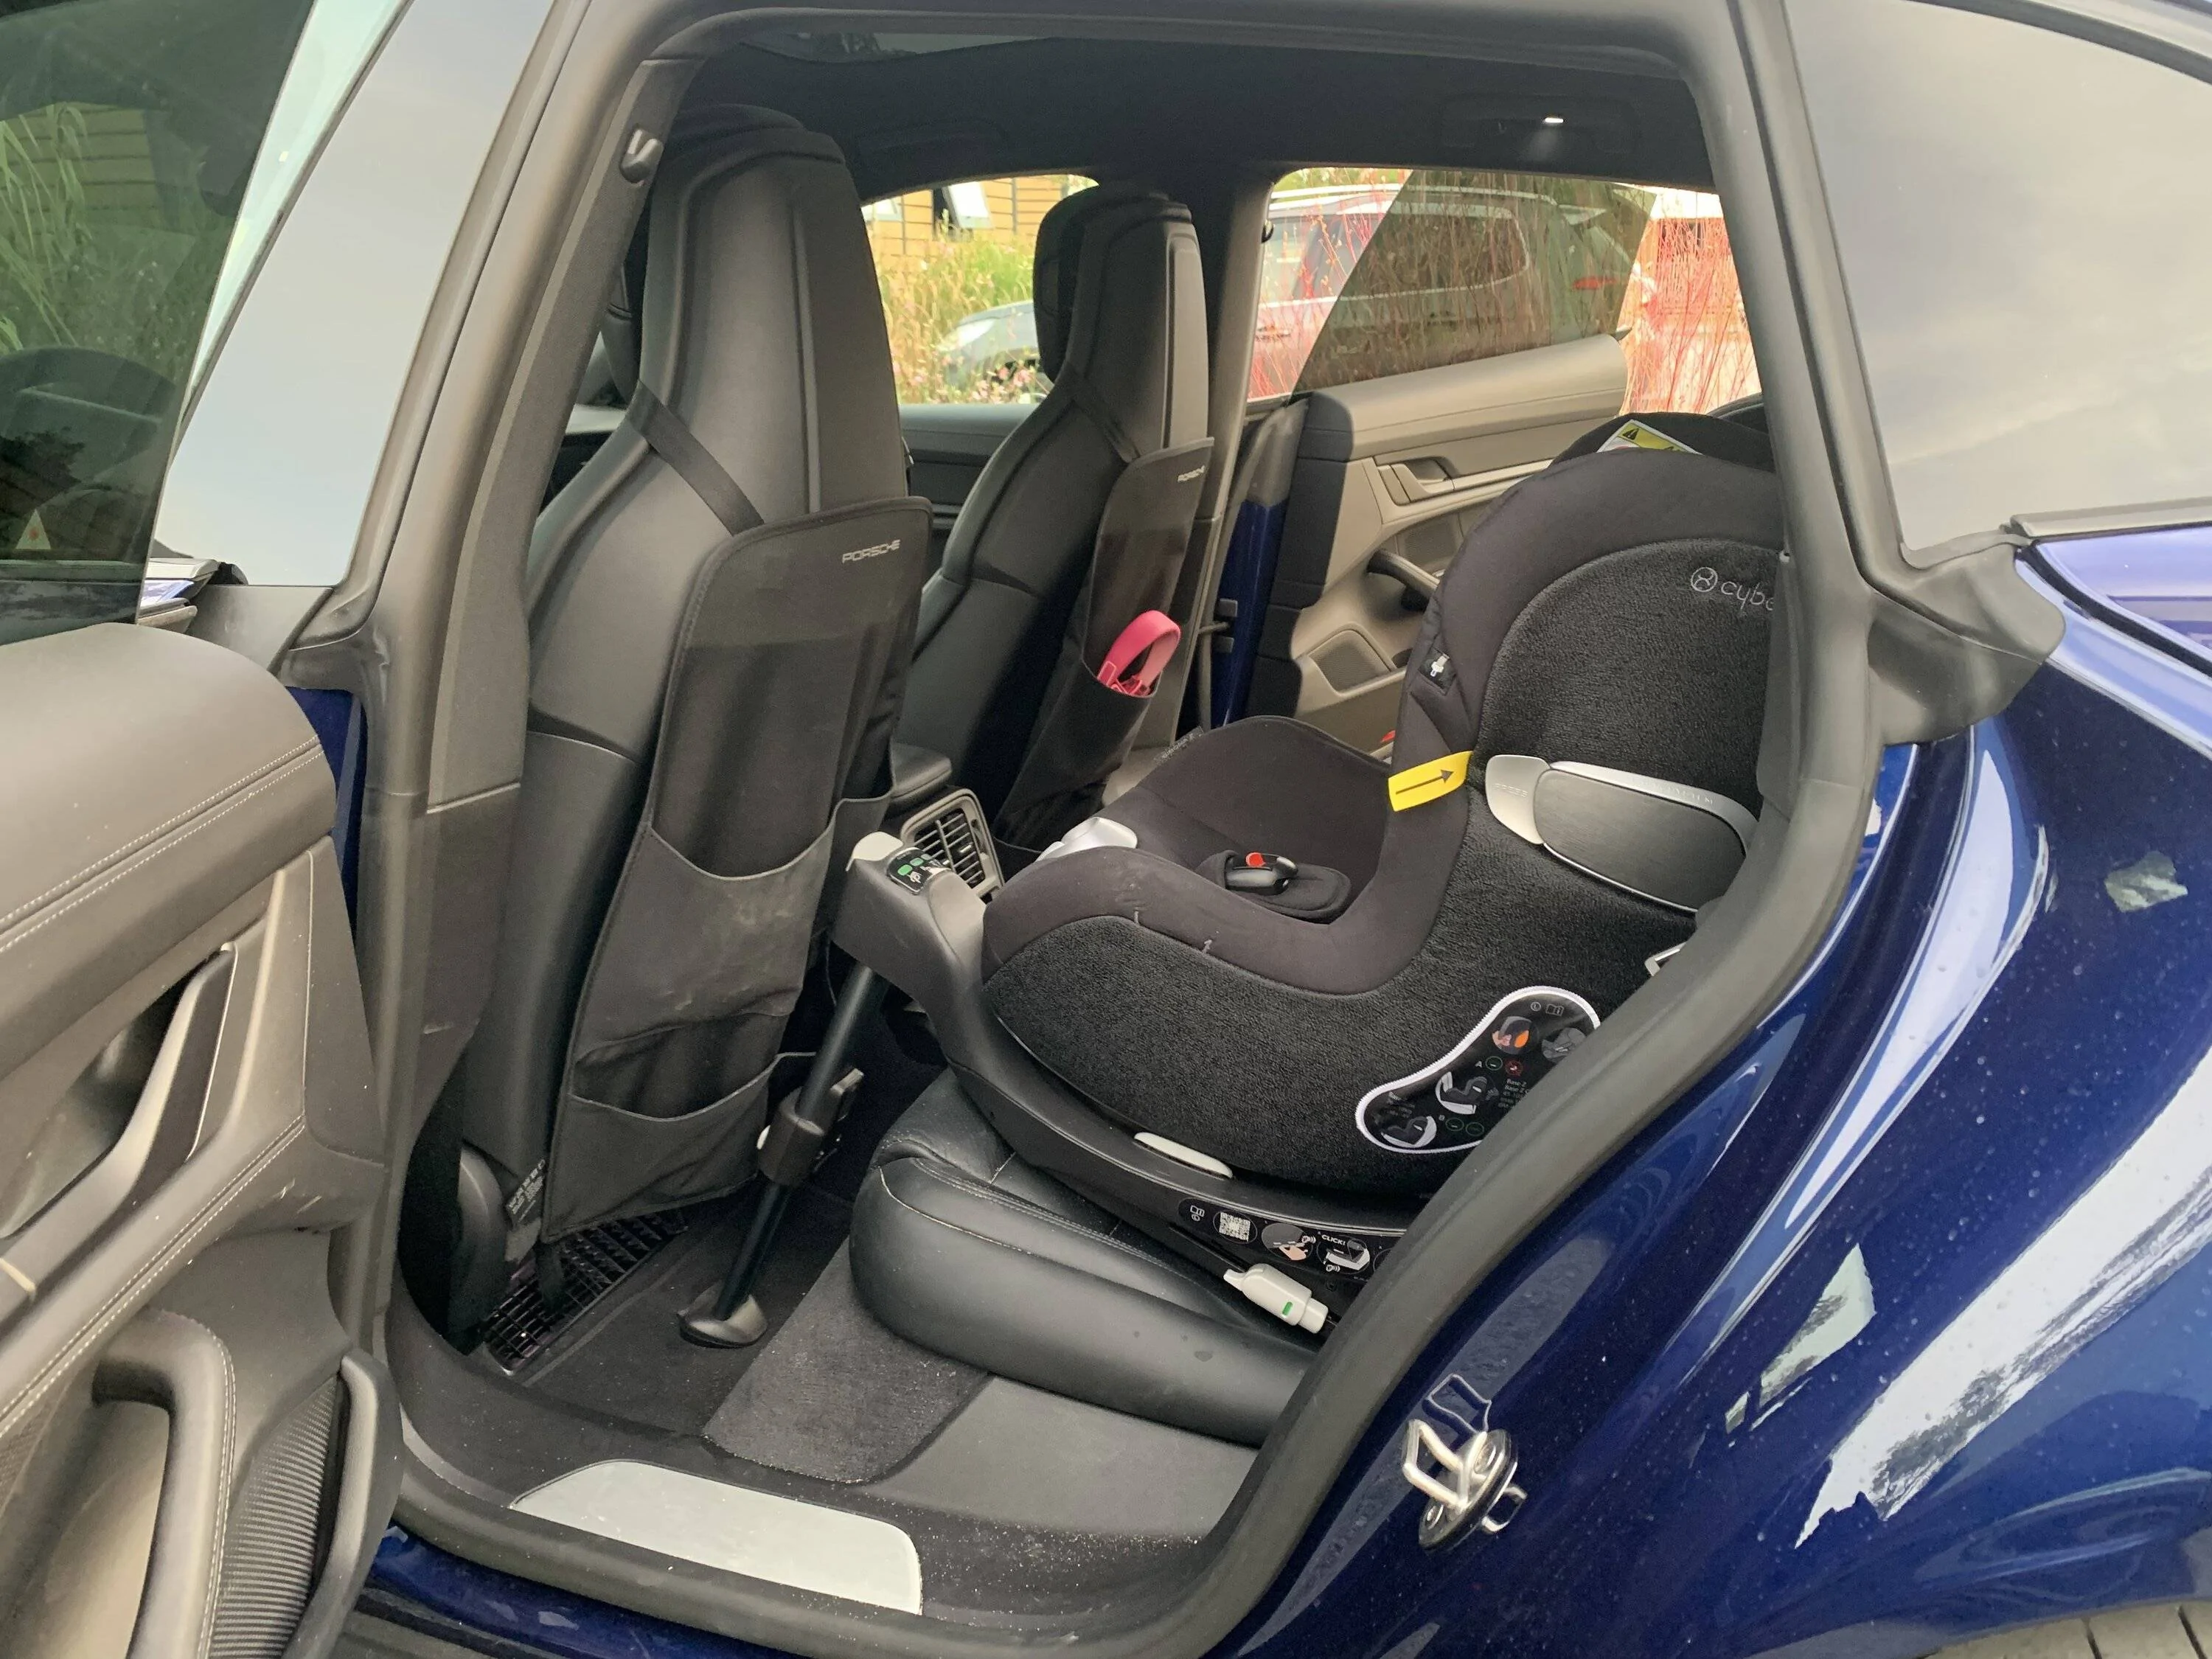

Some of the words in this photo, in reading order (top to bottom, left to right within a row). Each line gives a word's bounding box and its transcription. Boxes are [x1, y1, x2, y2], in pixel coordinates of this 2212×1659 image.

[842, 539, 901, 564] PORSCHE
[1721, 582, 1774, 611] cybe
[1321, 1234, 1346, 1246] CLICK!
